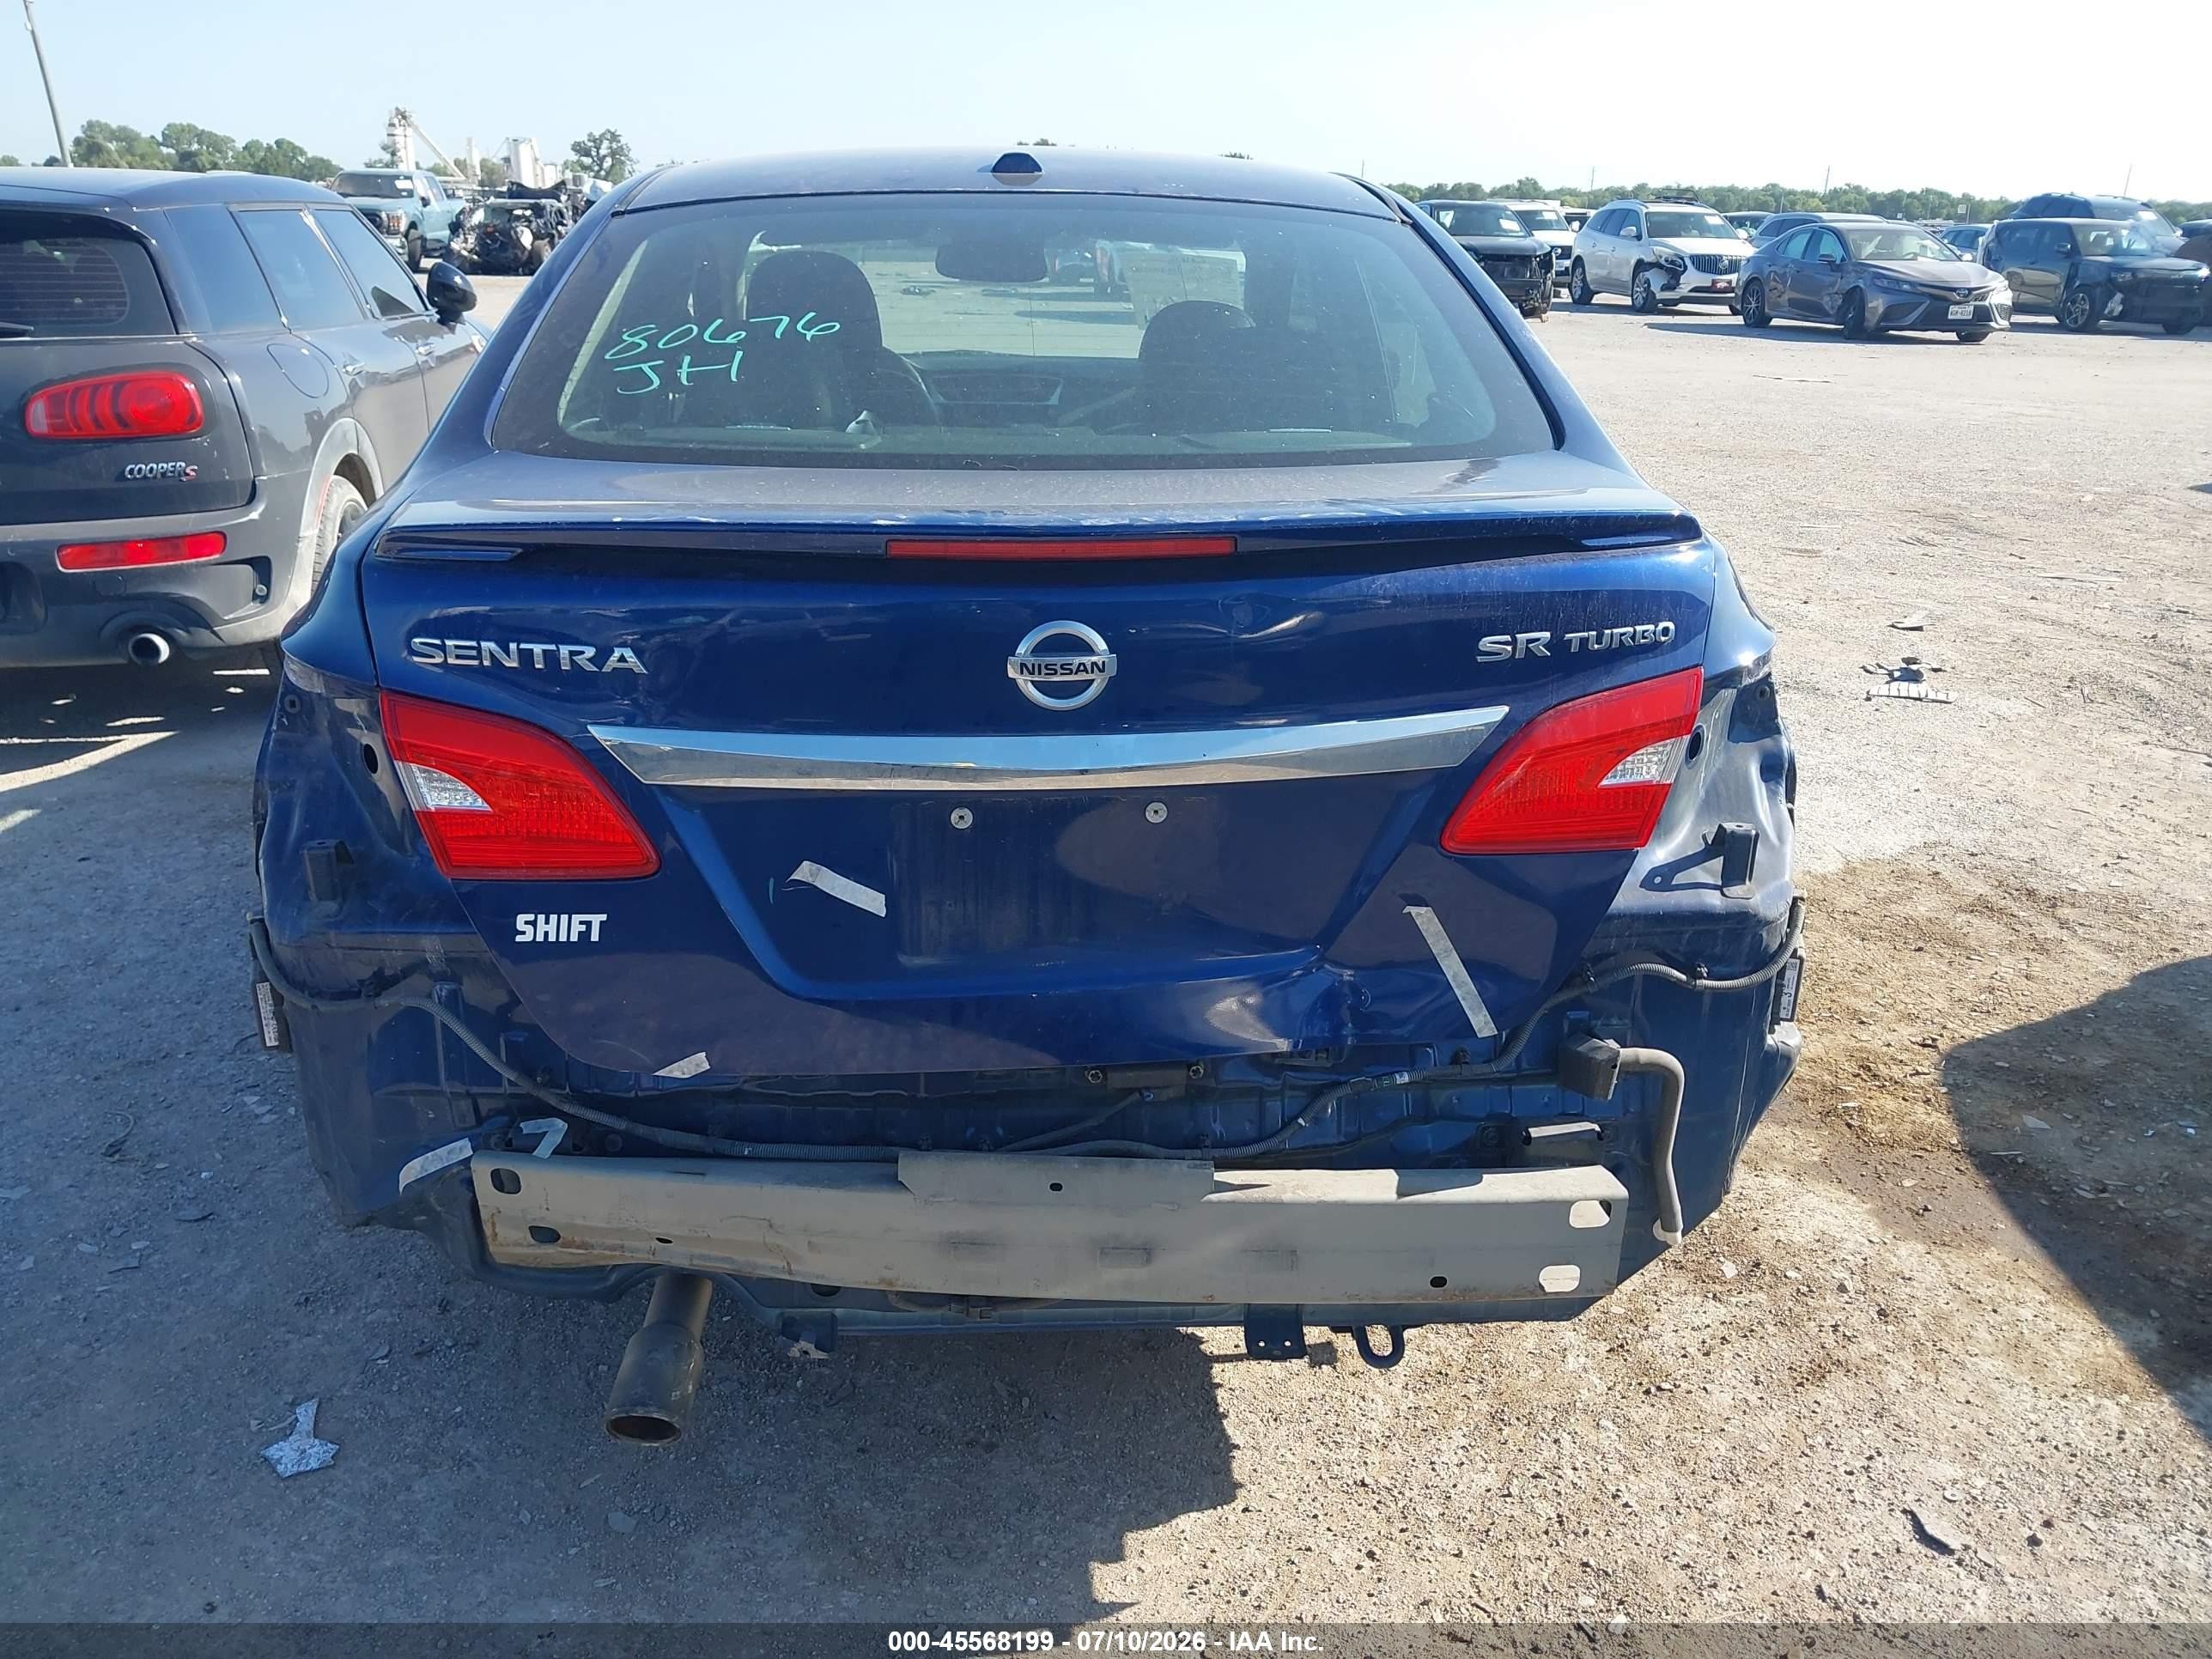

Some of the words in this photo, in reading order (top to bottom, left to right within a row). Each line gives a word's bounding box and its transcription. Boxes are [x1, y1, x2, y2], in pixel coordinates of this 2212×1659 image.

[604, 312, 841, 359] 80676
[125, 461, 186, 479] COOPER
[410, 637, 649, 674] SENTRA
[1476, 631, 1551, 663] SR
[1564, 621, 1675, 653] TURBO
[1019, 659, 1106, 676] NISSAN
[514, 913, 608, 942] SHIFT
